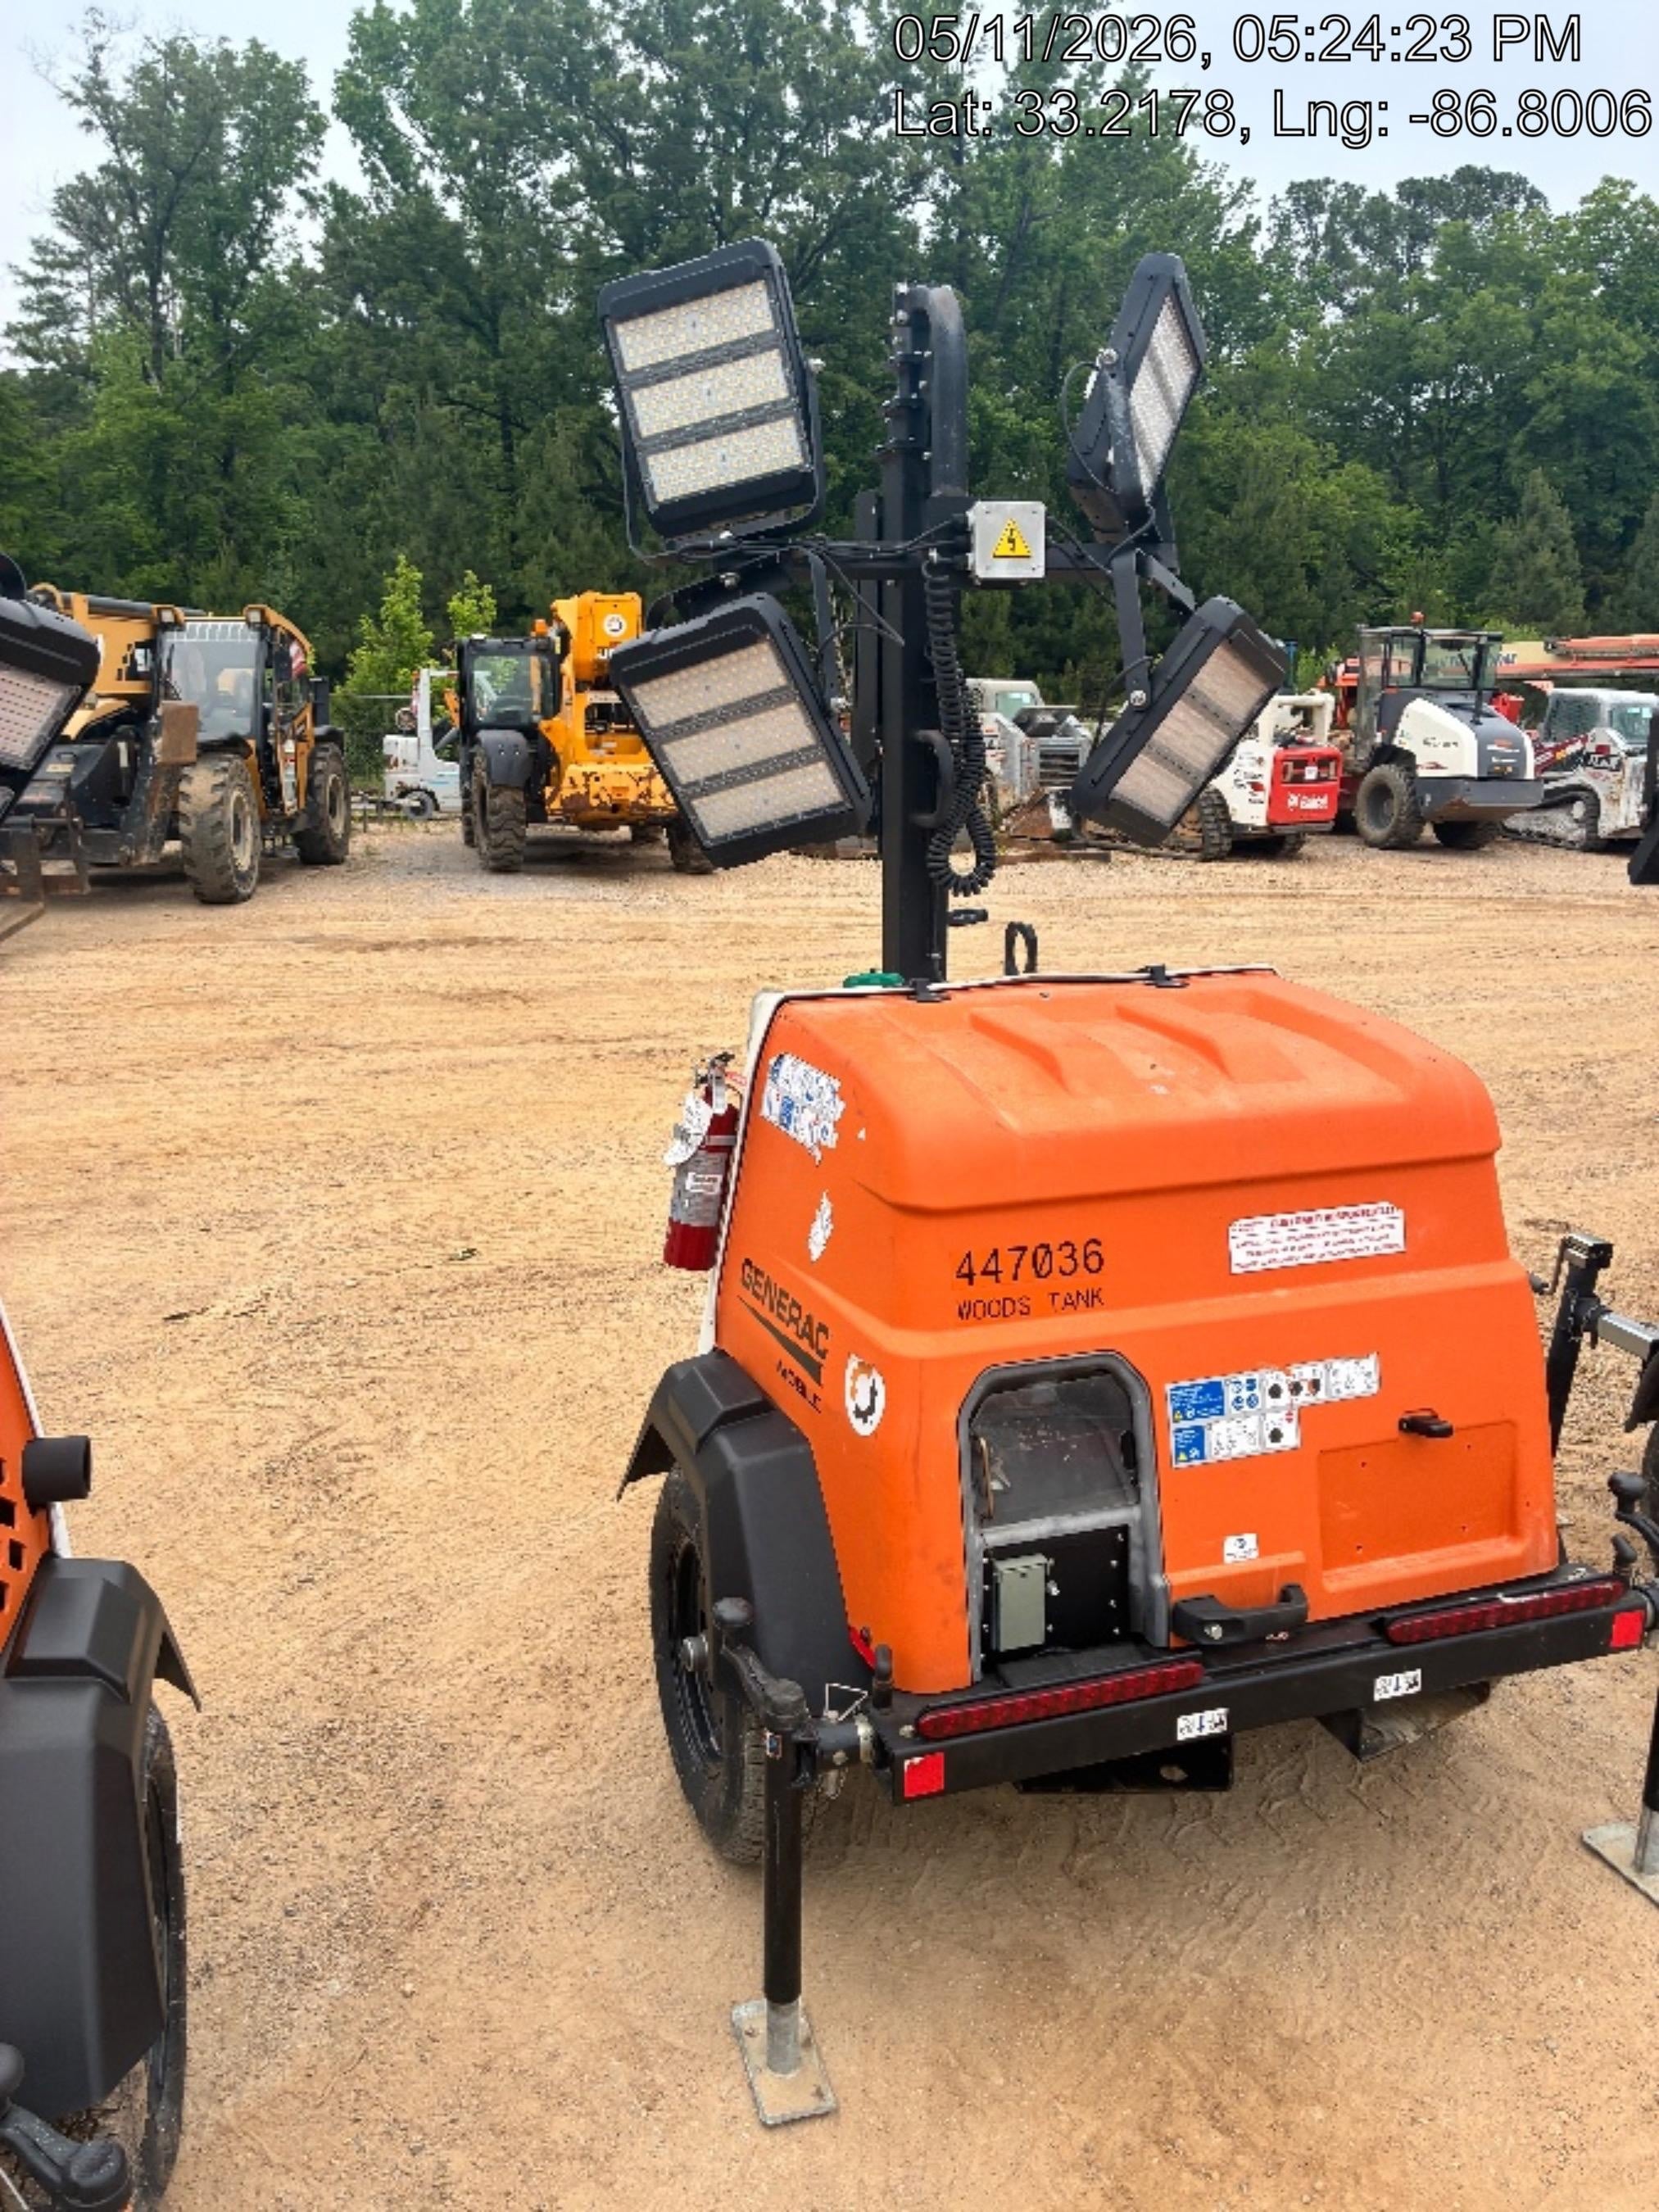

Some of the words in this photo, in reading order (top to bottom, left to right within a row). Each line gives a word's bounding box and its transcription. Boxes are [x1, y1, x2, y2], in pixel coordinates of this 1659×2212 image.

[955, 1238, 1104, 1286] 447036
[741, 1258, 829, 1360] GENERAC
[957, 1295, 1031, 1321] WOODS
[1048, 1287, 1105, 1313] TANK
